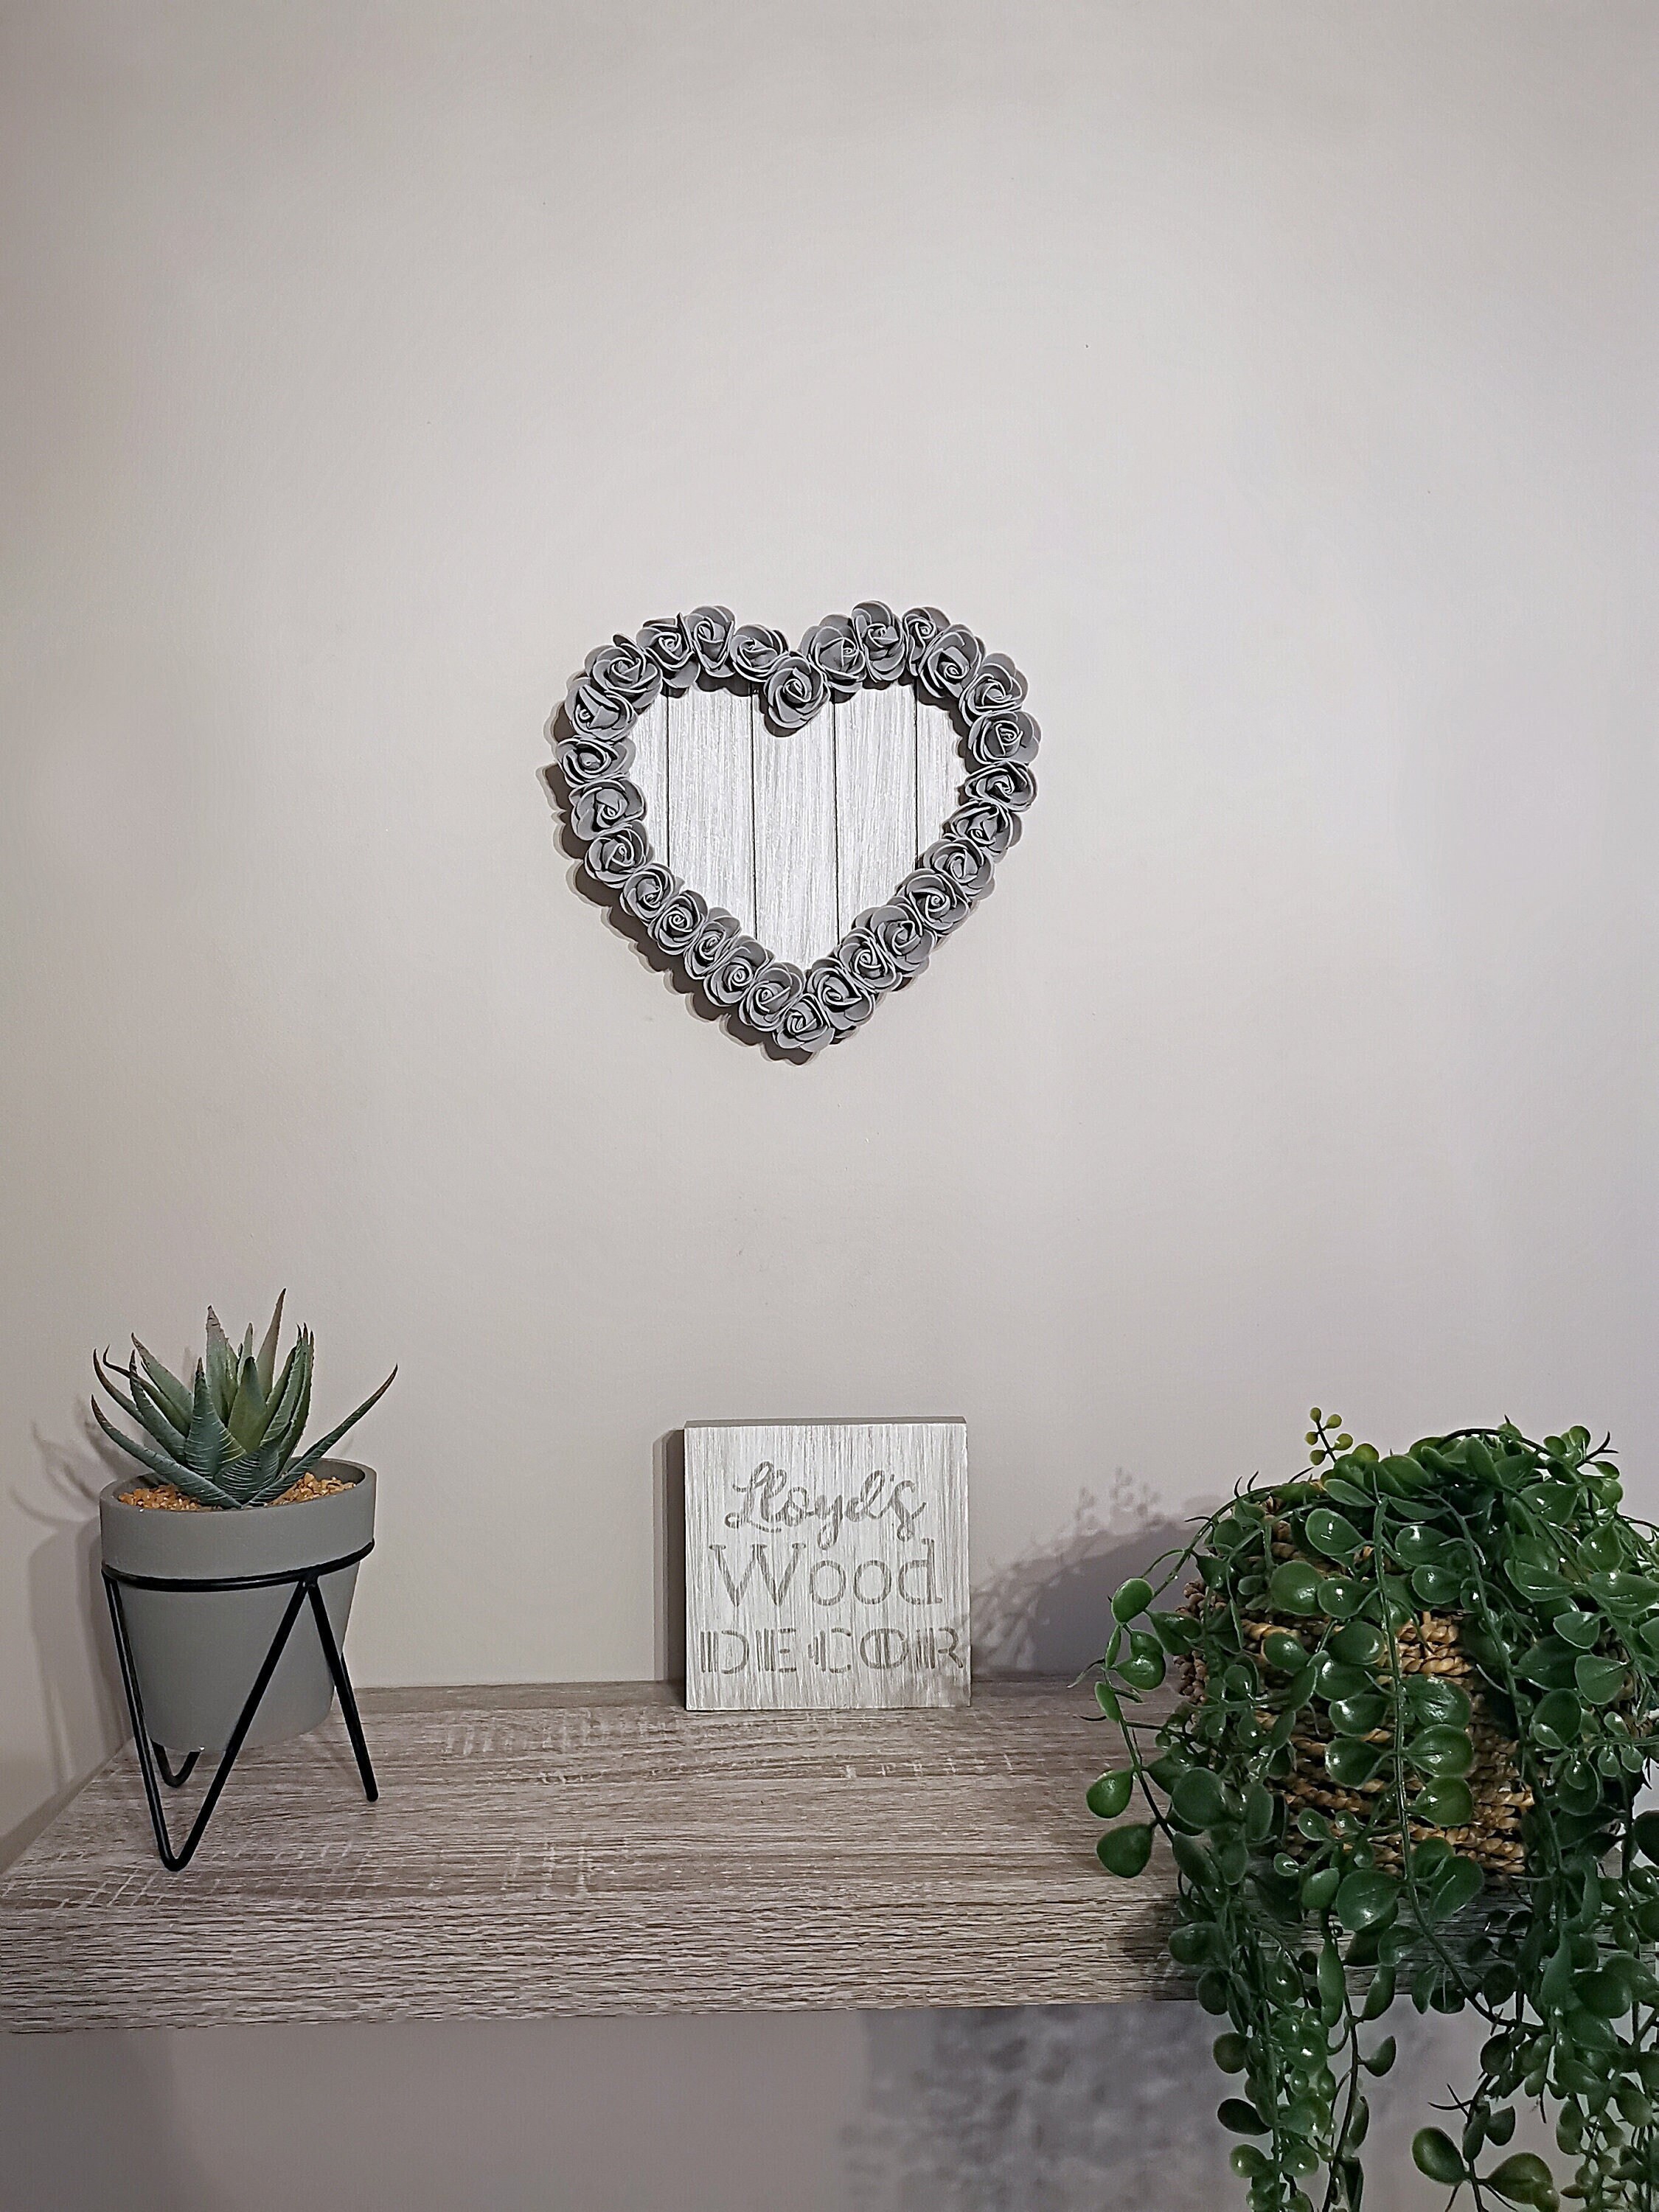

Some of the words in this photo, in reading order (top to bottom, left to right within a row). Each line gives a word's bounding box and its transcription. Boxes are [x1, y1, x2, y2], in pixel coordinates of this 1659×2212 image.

[724, 1461, 927, 1550] Lloyd's
[709, 1537, 943, 1608] Wood
[700, 1627, 964, 1674] DECOR
